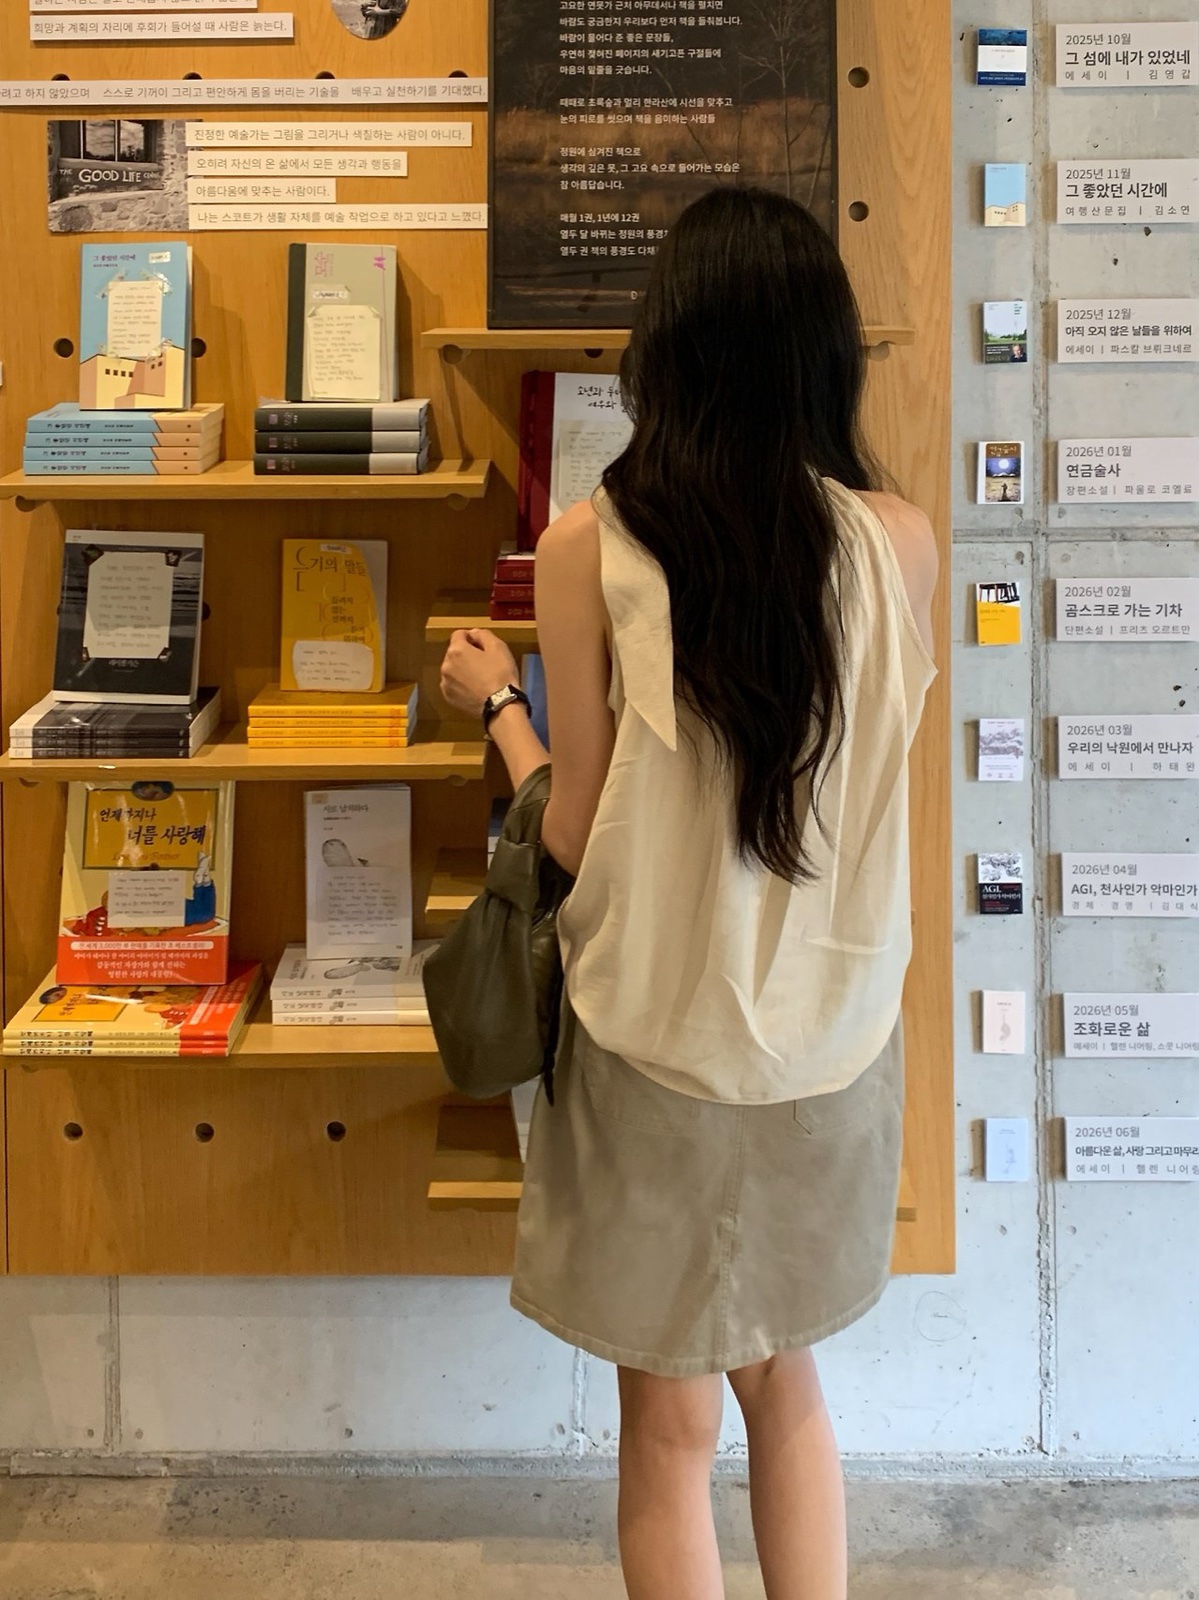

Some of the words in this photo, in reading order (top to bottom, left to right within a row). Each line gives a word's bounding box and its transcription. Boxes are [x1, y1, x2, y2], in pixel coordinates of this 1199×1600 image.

[34, 22, 64, 34] 희망과
[68, 22, 98, 33] 계획의
[102, 22, 133, 33] 자리에
[136, 21, 167, 33] 후회가
[171, 21, 202, 32] 들어설
[205, 21, 215, 32] 때
[218, 20, 249, 32] 사람은
[253, 20, 287, 32] 늙는다.
[1066, 34, 1104, 45] 2025년
[1108, 34, 1131, 45] 10월
[1066, 52, 1079, 65] 그
[1084, 51, 1111, 66] 섬에
[1116, 50, 1143, 65] 내가
[1148, 50, 1190, 65] 있었네
[560, 66, 585, 75] 마음의
[588, 66, 613, 75] 밑줄을
[616, 66, 652, 75] 긋습니다.
[0, 88, 21, 99] 려고
[25, 88, 45, 99] 하지
[49, 88, 90, 99] 않았으며
[103, 88, 134, 98] 스스로
[137, 88, 168, 98] 기꺼이
[172, 88, 202, 98] 그리고
[206, 88, 248, 98] 편안하게
[251, 88, 271, 98] 몸을
[274, 88, 305, 98] 버리는
[309, 86, 340, 98] 기술을
[352, 86, 382, 97] 배우고
[386, 86, 437, 97] 실천하기를
[441, 85, 485, 97] 기대했다.
[195, 130, 225, 140] 진정한
[228, 130, 270, 140] 예술가는
[274, 130, 304, 140] 그림을
[308, 130, 349, 140] 그리거나
[352, 130, 393, 140] 색칠하는
[398, 130, 427, 140] 사람이
[431, 130, 465, 140] 아니다.
[560, 148, 586, 157] 정원에
[616, 148, 641, 157] 책으로
[197, 158, 227, 170] 오히려
[231, 158, 261, 170] 자신의
[266, 158, 275, 170] 온
[279, 158, 309, 170] 삶에서
[313, 158, 333, 170] 모든
[338, 159, 367, 170] 생각과
[372, 159, 401, 170] 행동을
[560, 164, 586, 173] 생각의
[588, 164, 605, 173] 깊은
[620, 164, 629, 173] 그
[632, 164, 648, 173] 고요
[650, 164, 676, 173] 속으로
[678, 164, 712, 173] 들어가는
[714, 164, 740, 173] 모습은
[79, 169, 119, 183] GOOD
[122, 170, 141, 183] LIFE
[1066, 168, 1104, 180] 2025년
[1108, 168, 1131, 179] 11월
[560, 180, 568, 190] 참
[570, 180, 625, 190] 아름답습니다.
[1066, 184, 1079, 197] 그
[1083, 183, 1123, 198] 좋았던
[1127, 182, 1168, 198] 시간에
[196, 186, 248, 197] 아름다움에
[251, 186, 282, 197] 맞추는
[286, 186, 330, 197] 사람이다.
[198, 212, 218, 223] 나는
[222, 212, 263, 223] 스코트가
[267, 212, 287, 223] 생활
[290, 212, 321, 223] 자체를
[325, 212, 344, 223] 예술
[349, 212, 389, 223] 작업으로
[394, 212, 413, 223] 하고
[417, 212, 447, 223] 있다고
[451, 212, 485, 223] 느꼈다.
[560, 213, 577, 223] 매월
[622, 213, 640, 223] 12권
[1066, 309, 1104, 320] 2025년
[1108, 308, 1131, 320] 12월
[1066, 326, 1084, 337] 아직
[1088, 326, 1106, 336] 오지
[1110, 326, 1129, 336] 않은
[1132, 326, 1160, 336] 날들을
[1164, 325, 1192, 336] 위하여
[1066, 345, 1094, 355] 에세이
[1111, 345, 1139, 355] 파스칼
[1144, 344, 1192, 354] 브뤼크네르
[578, 386, 604, 397] 소년과
[588, 400, 617, 409] 여우와
[1066, 446, 1104, 457] 2026년
[1108, 446, 1132, 457] 01월
[1066, 464, 1121, 478] 연금술사
[1065, 586, 1103, 597] 2026년
[1107, 586, 1131, 597] 02월
[1065, 604, 1120, 618] 곰스크로
[1124, 604, 1151, 617] 가는
[1156, 604, 1182, 617] 기차
[1065, 626, 1104, 636] 단편소설
[1120, 626, 1148, 635] 프리츠
[1152, 625, 1190, 635] 오르트만
[1068, 725, 1105, 736] 2026년
[1108, 724, 1132, 736] 03월
[1068, 742, 1102, 754] 우리의
[1107, 742, 1154, 754] 낙원에서
[1158, 742, 1193, 754] 만나자
[128, 826, 158, 845] 너를
[161, 825, 207, 845] 사랑해
[1072, 864, 1110, 875] 2026년
[1113, 864, 1137, 875] 04월
[1071, 884, 1097, 896] AGI,
[1100, 884, 1147, 896] 천사인가
[1150, 884, 1197, 896] 악마인가
[1074, 1006, 1111, 1016] 2026년
[1115, 1005, 1139, 1016] 05월
[1074, 1022, 1132, 1037] 조화로운
[1137, 1022, 1151, 1037] 삶
[1076, 1127, 1113, 1138] 2026년
[1116, 1126, 1140, 1138] 06월
